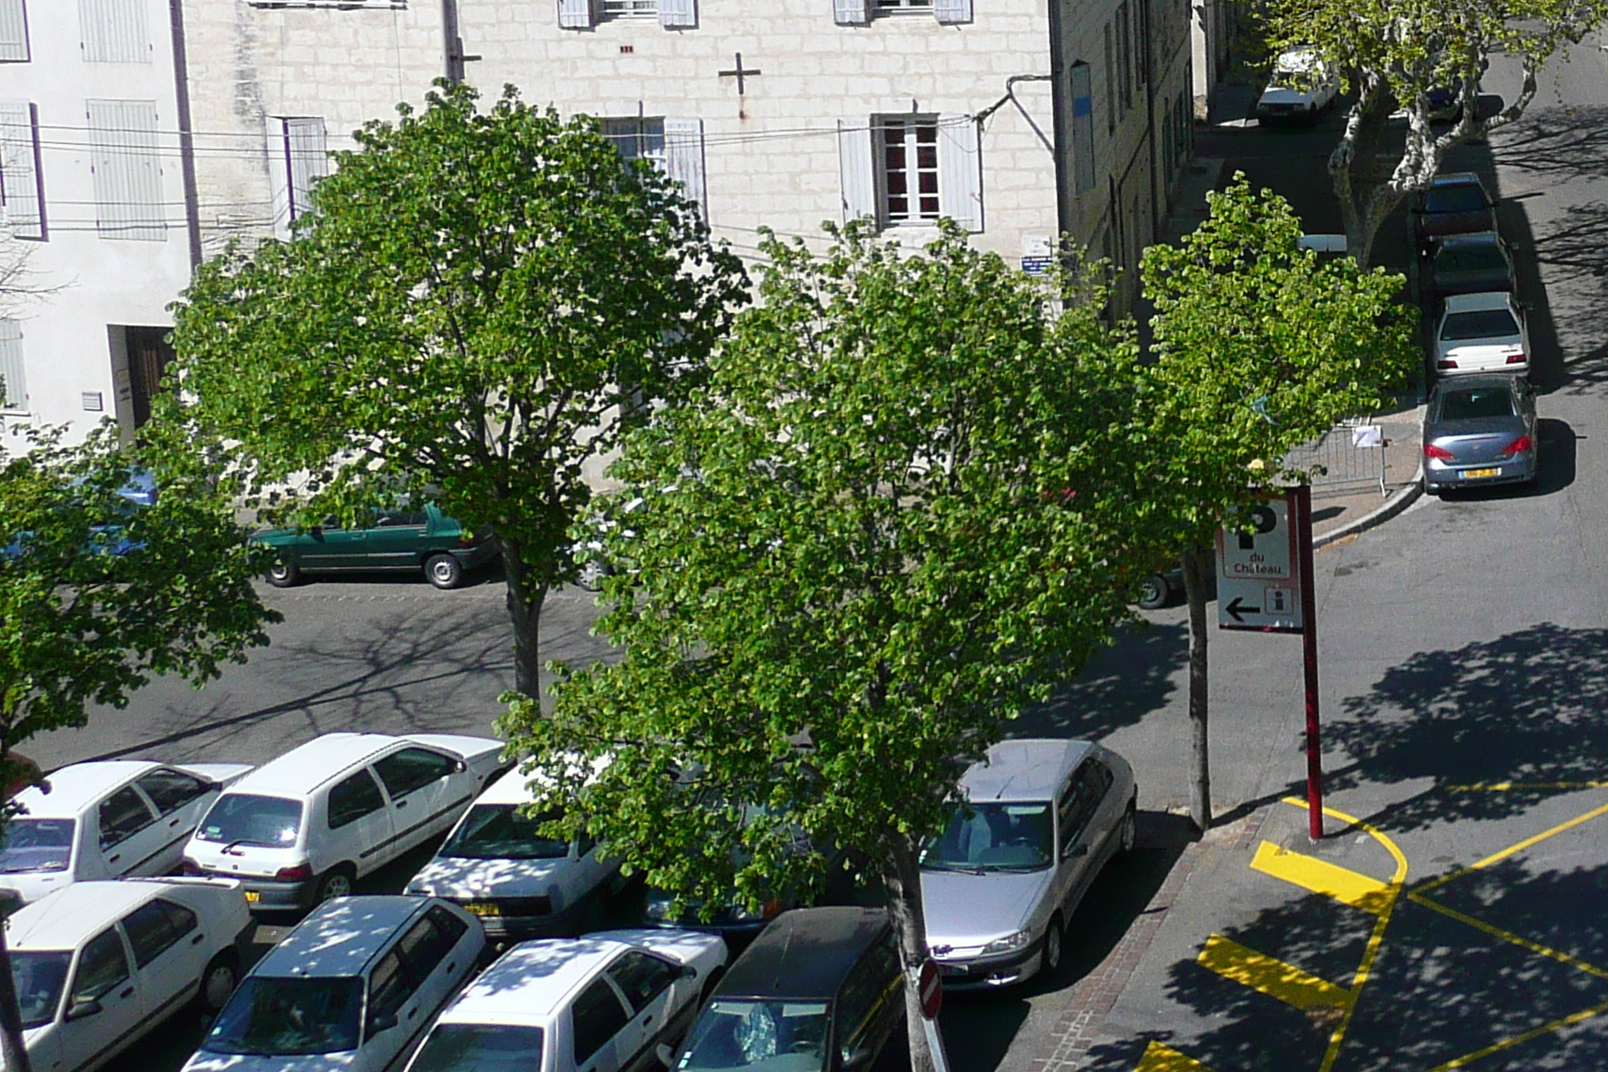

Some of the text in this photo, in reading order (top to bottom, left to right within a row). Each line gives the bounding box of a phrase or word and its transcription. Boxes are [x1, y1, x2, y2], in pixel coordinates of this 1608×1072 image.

[1239, 505, 1277, 550] P
[1250, 553, 1265, 563] du
[1234, 562, 1282, 575] Château
